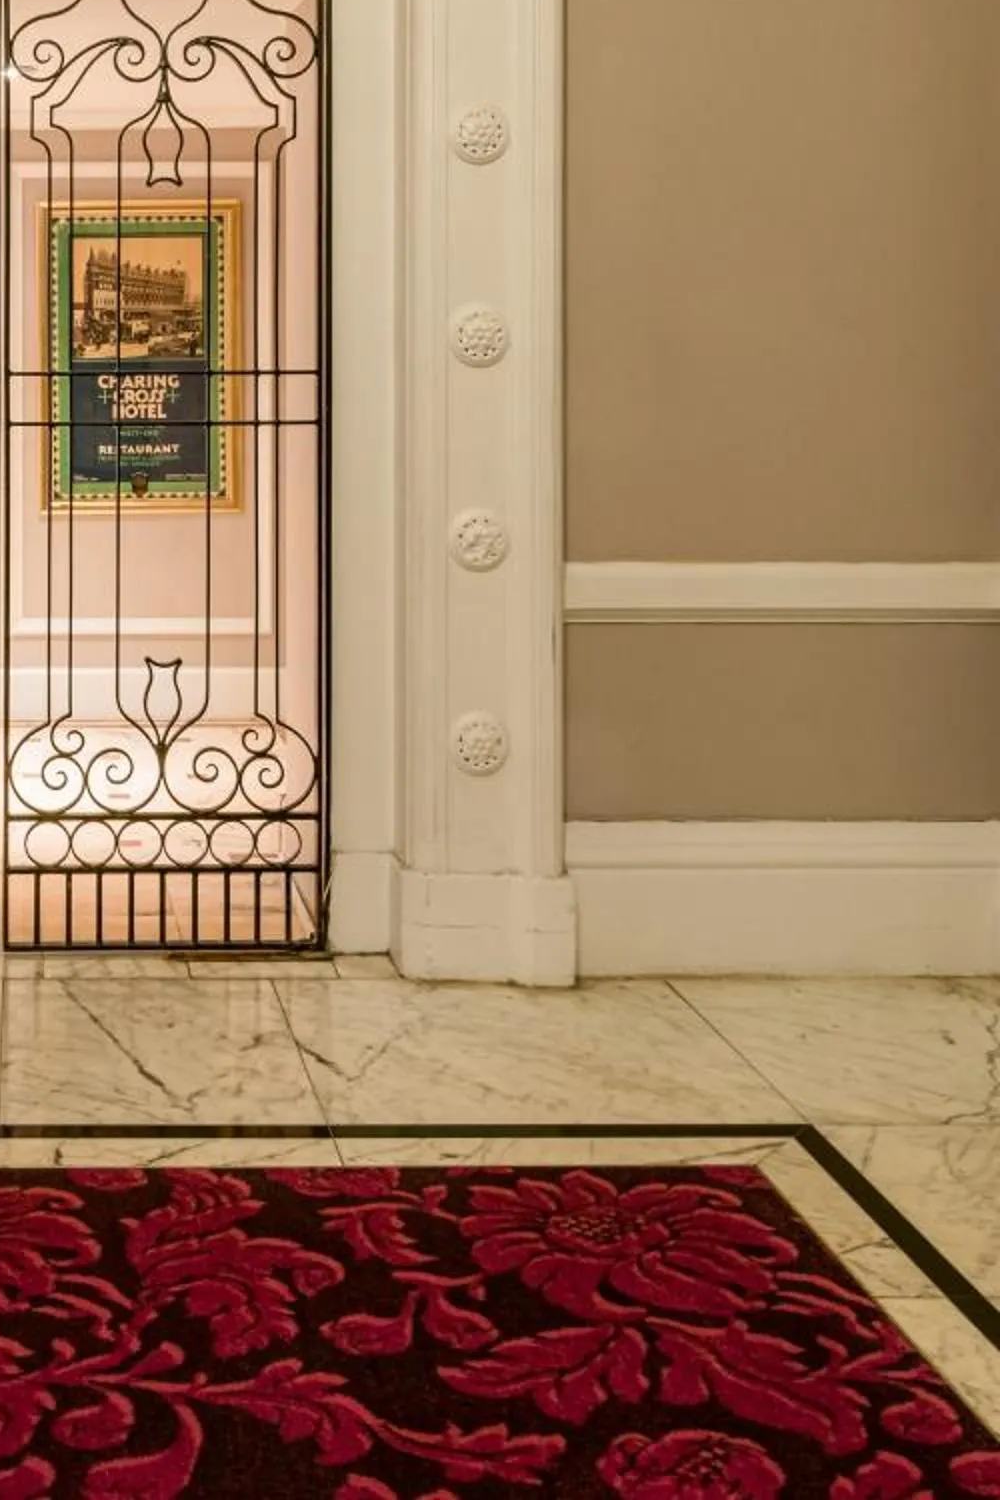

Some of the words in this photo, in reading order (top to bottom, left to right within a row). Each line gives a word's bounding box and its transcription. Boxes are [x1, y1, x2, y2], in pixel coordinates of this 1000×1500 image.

[97, 375, 180, 389] CHARING
[113, 389, 167, 403] CROSS
[112, 403, 167, 419] HOTEL
[98, 443, 180, 454] RETAURANT
